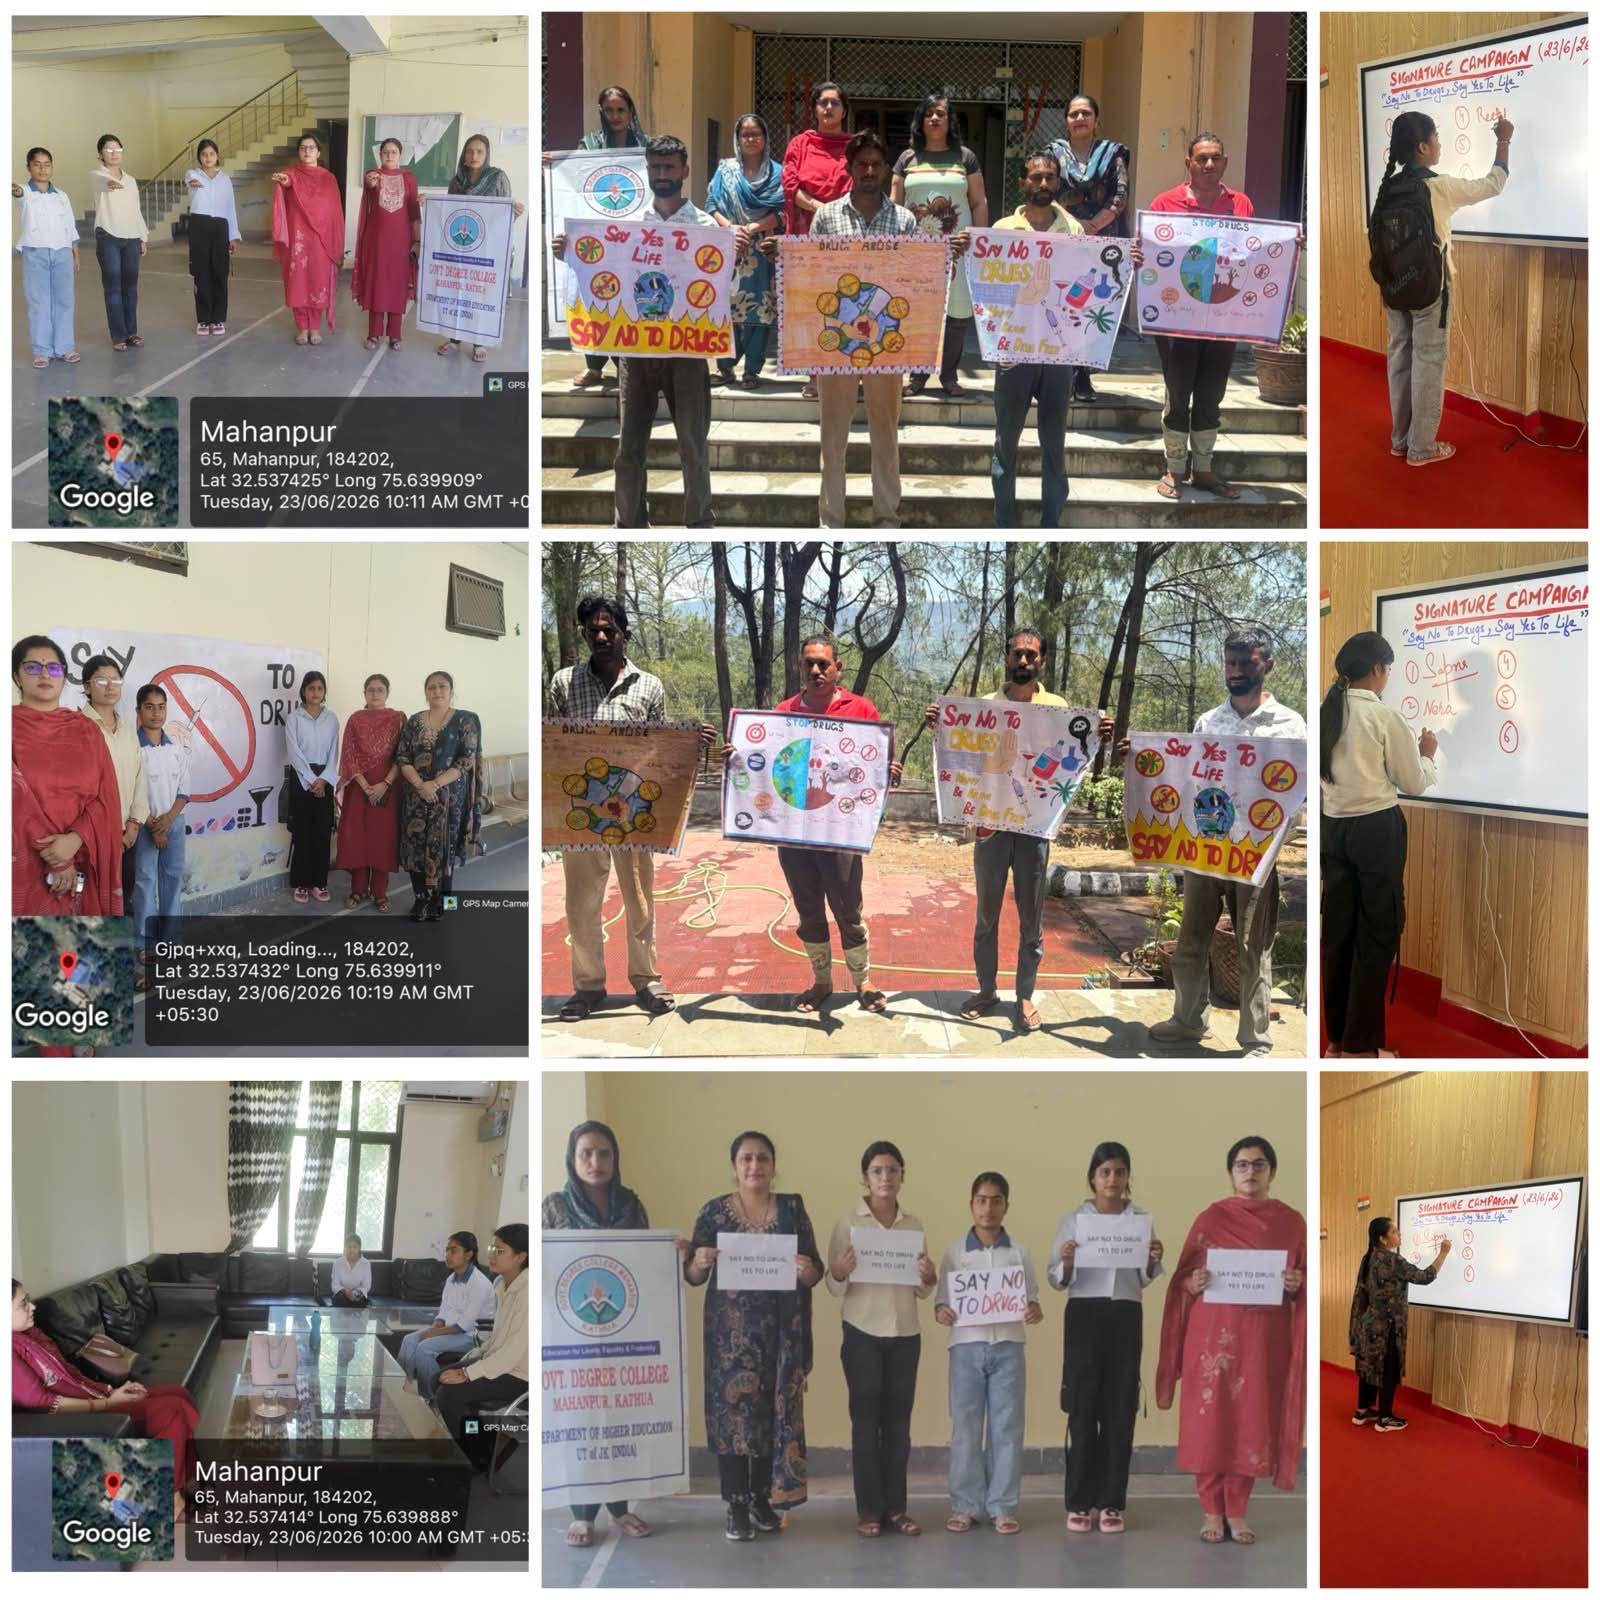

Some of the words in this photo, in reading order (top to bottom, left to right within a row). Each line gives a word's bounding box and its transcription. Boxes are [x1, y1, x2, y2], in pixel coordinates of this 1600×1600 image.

[1389, 61, 1453, 86] SIGNATURE
[1459, 45, 1532, 73] CAMPAIGN
[1453, 82, 1468, 98] Say
[1485, 76, 1494, 89] To
[1192, 218, 1216, 228] STOP
[1218, 220, 1249, 232] DRUGS
[979, 258, 1033, 284] DRUGS
[570, 318, 610, 347] SAY
[614, 325, 639, 347] NO
[644, 326, 664, 346] TO
[669, 325, 730, 353] DRUGS
[1414, 592, 1498, 621] SIGNATURE
[1428, 629, 1441, 640] No
[1445, 626, 1454, 637] To
[1495, 619, 1515, 641] Say
[1520, 618, 1536, 631] Yes
[1537, 615, 1550, 630] To
[267, 663, 295, 689] TO
[786, 718, 810, 728] STOP
[813, 721, 844, 733] DRUGS
[1132, 832, 1172, 860] SAY
[1176, 839, 1199, 861] NO
[1203, 844, 1223, 866] TO
[1417, 1199, 1463, 1213] SIGNATURE
[1467, 1193, 1518, 1208] CAMPAIGN
[954, 1272, 990, 1292] SAY
[1001, 1270, 1024, 1289] NO
[956, 1295, 979, 1314] TO
[982, 1291, 1026, 1315] DRUGS
[571, 1366, 617, 1388] DEGREE
[620, 1364, 670, 1386] COLLEGE
[614, 1392, 654, 1409] KATHUA
[590, 1426, 601, 1440] OF
[602, 1424, 630, 1439] HIGHER
[631, 1421, 673, 1436] EDUCATION
